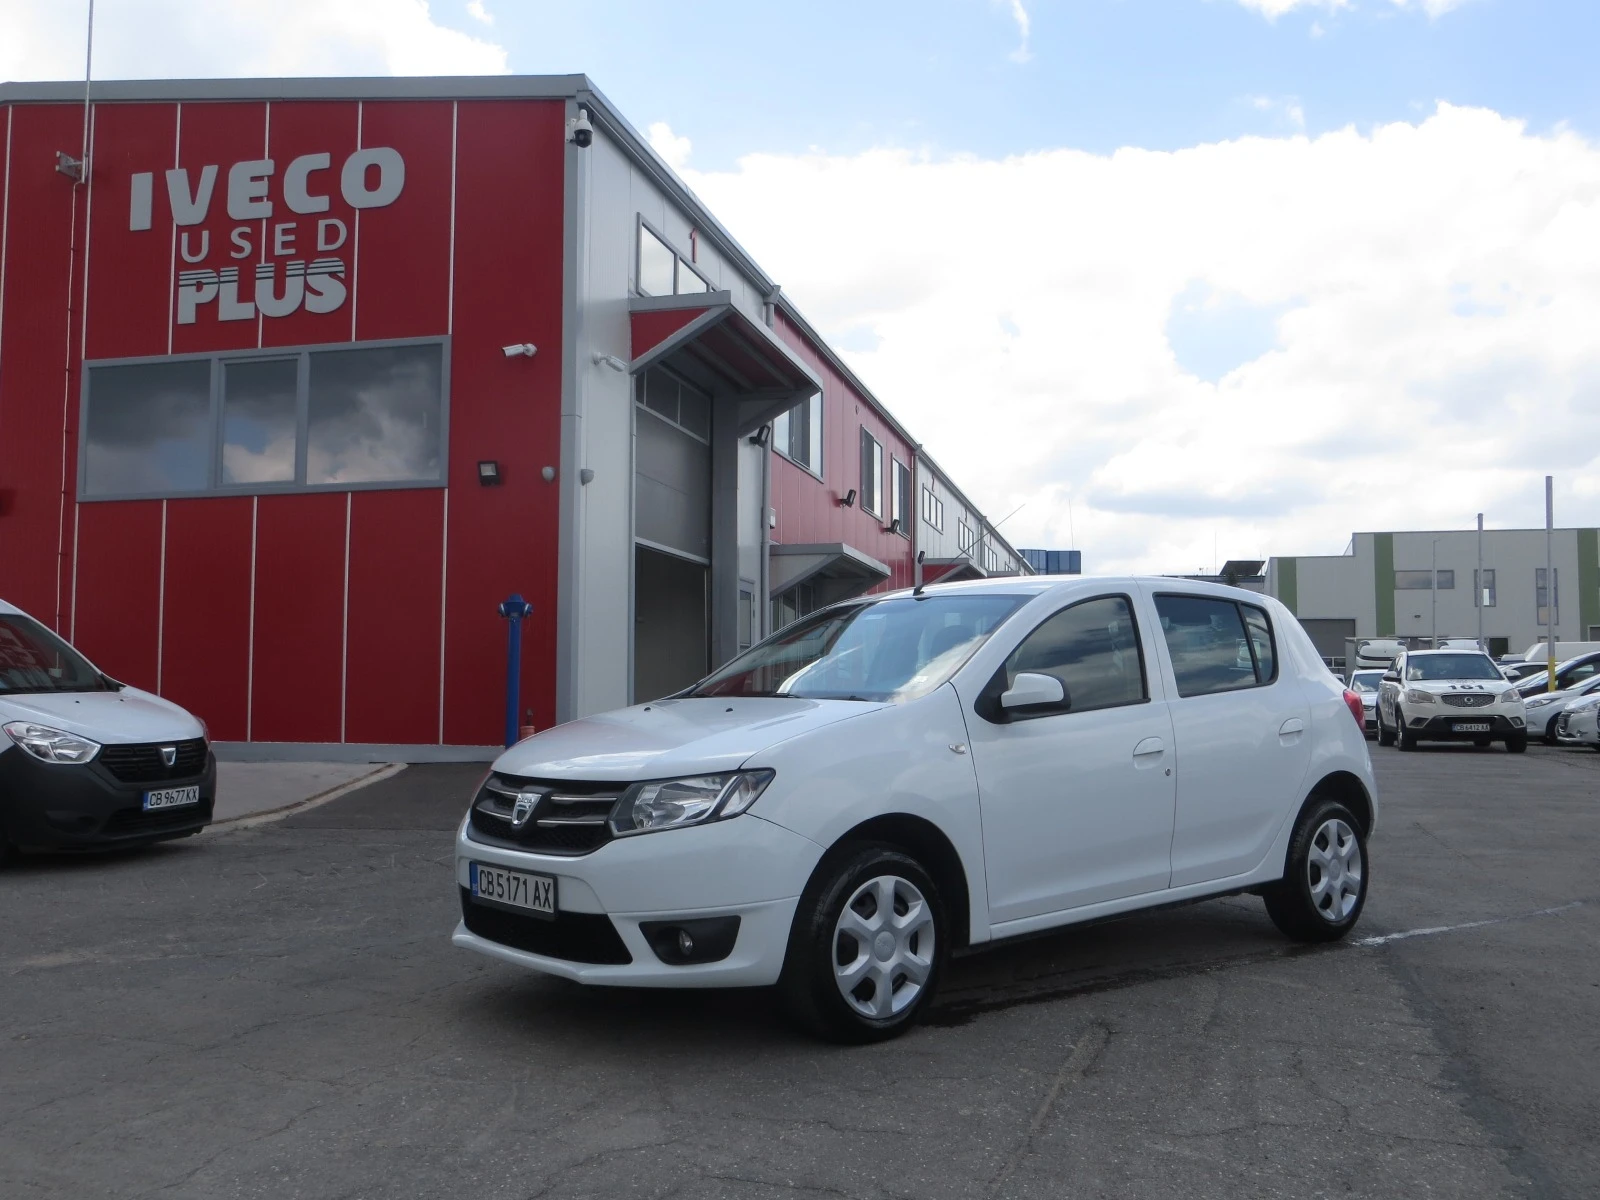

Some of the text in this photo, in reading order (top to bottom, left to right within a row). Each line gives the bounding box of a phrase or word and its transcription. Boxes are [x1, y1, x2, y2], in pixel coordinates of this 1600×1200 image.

[129, 147, 405, 231] IVECO
[181, 218, 347, 263] USED
[177, 257, 347, 325] PLUS
